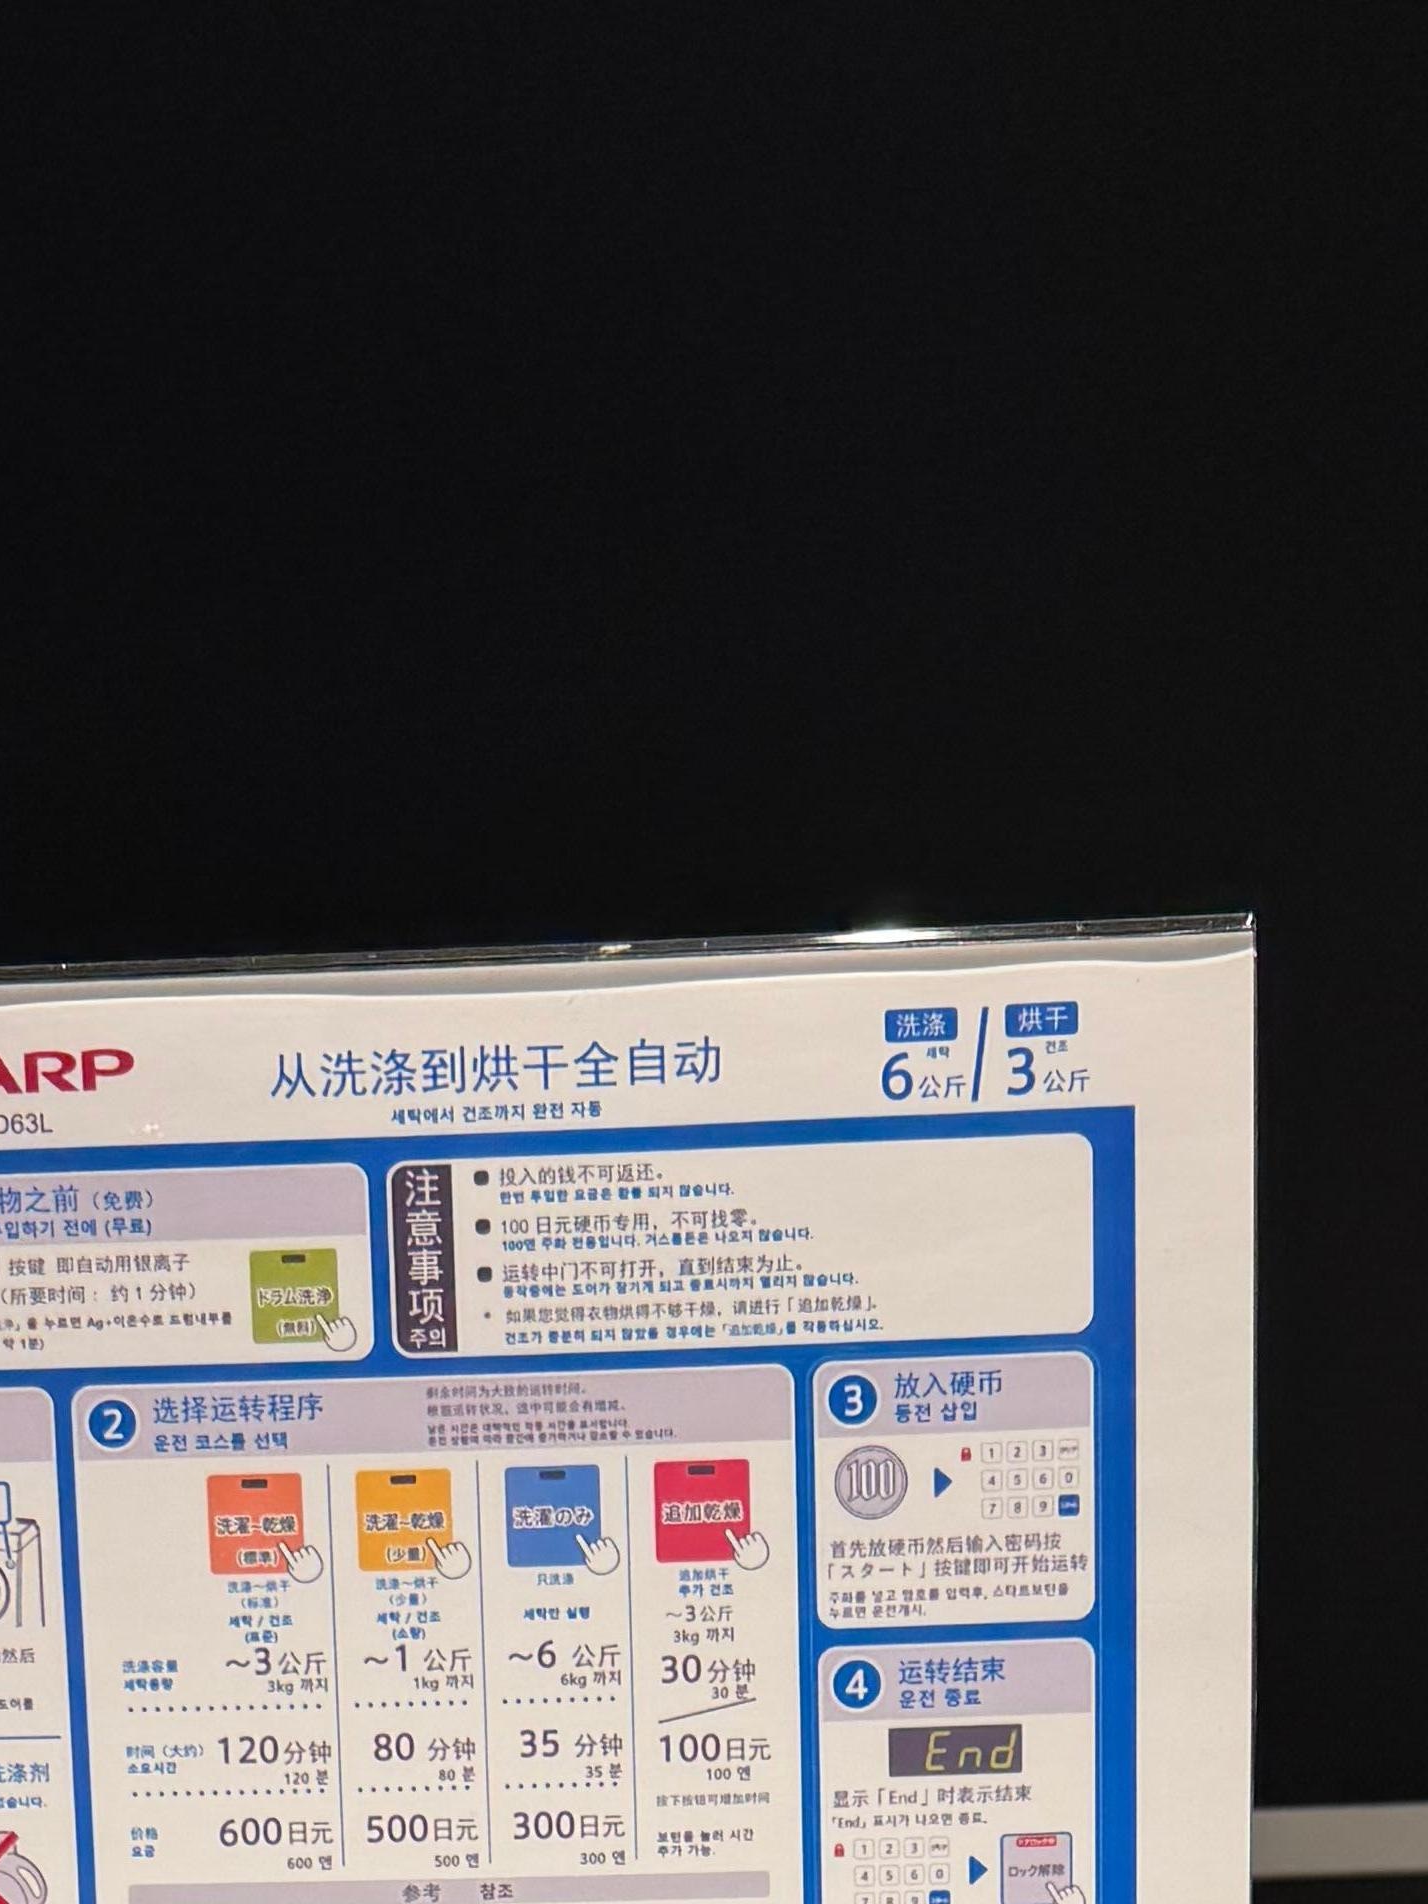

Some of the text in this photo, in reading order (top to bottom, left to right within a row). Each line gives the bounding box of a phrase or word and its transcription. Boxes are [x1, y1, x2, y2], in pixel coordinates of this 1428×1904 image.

[895, 1012, 946, 1038] 洗涤
[1017, 1007, 1069, 1033] 烘干
[272, 1034, 721, 1098] 从洗涤到烘干全自动
[405, 1168, 445, 1324] 注意事项
[894, 1369, 1003, 1400] 放入硬币
[152, 1394, 324, 1425] 选择运转程序
[898, 1657, 1006, 1685] 运转结束
